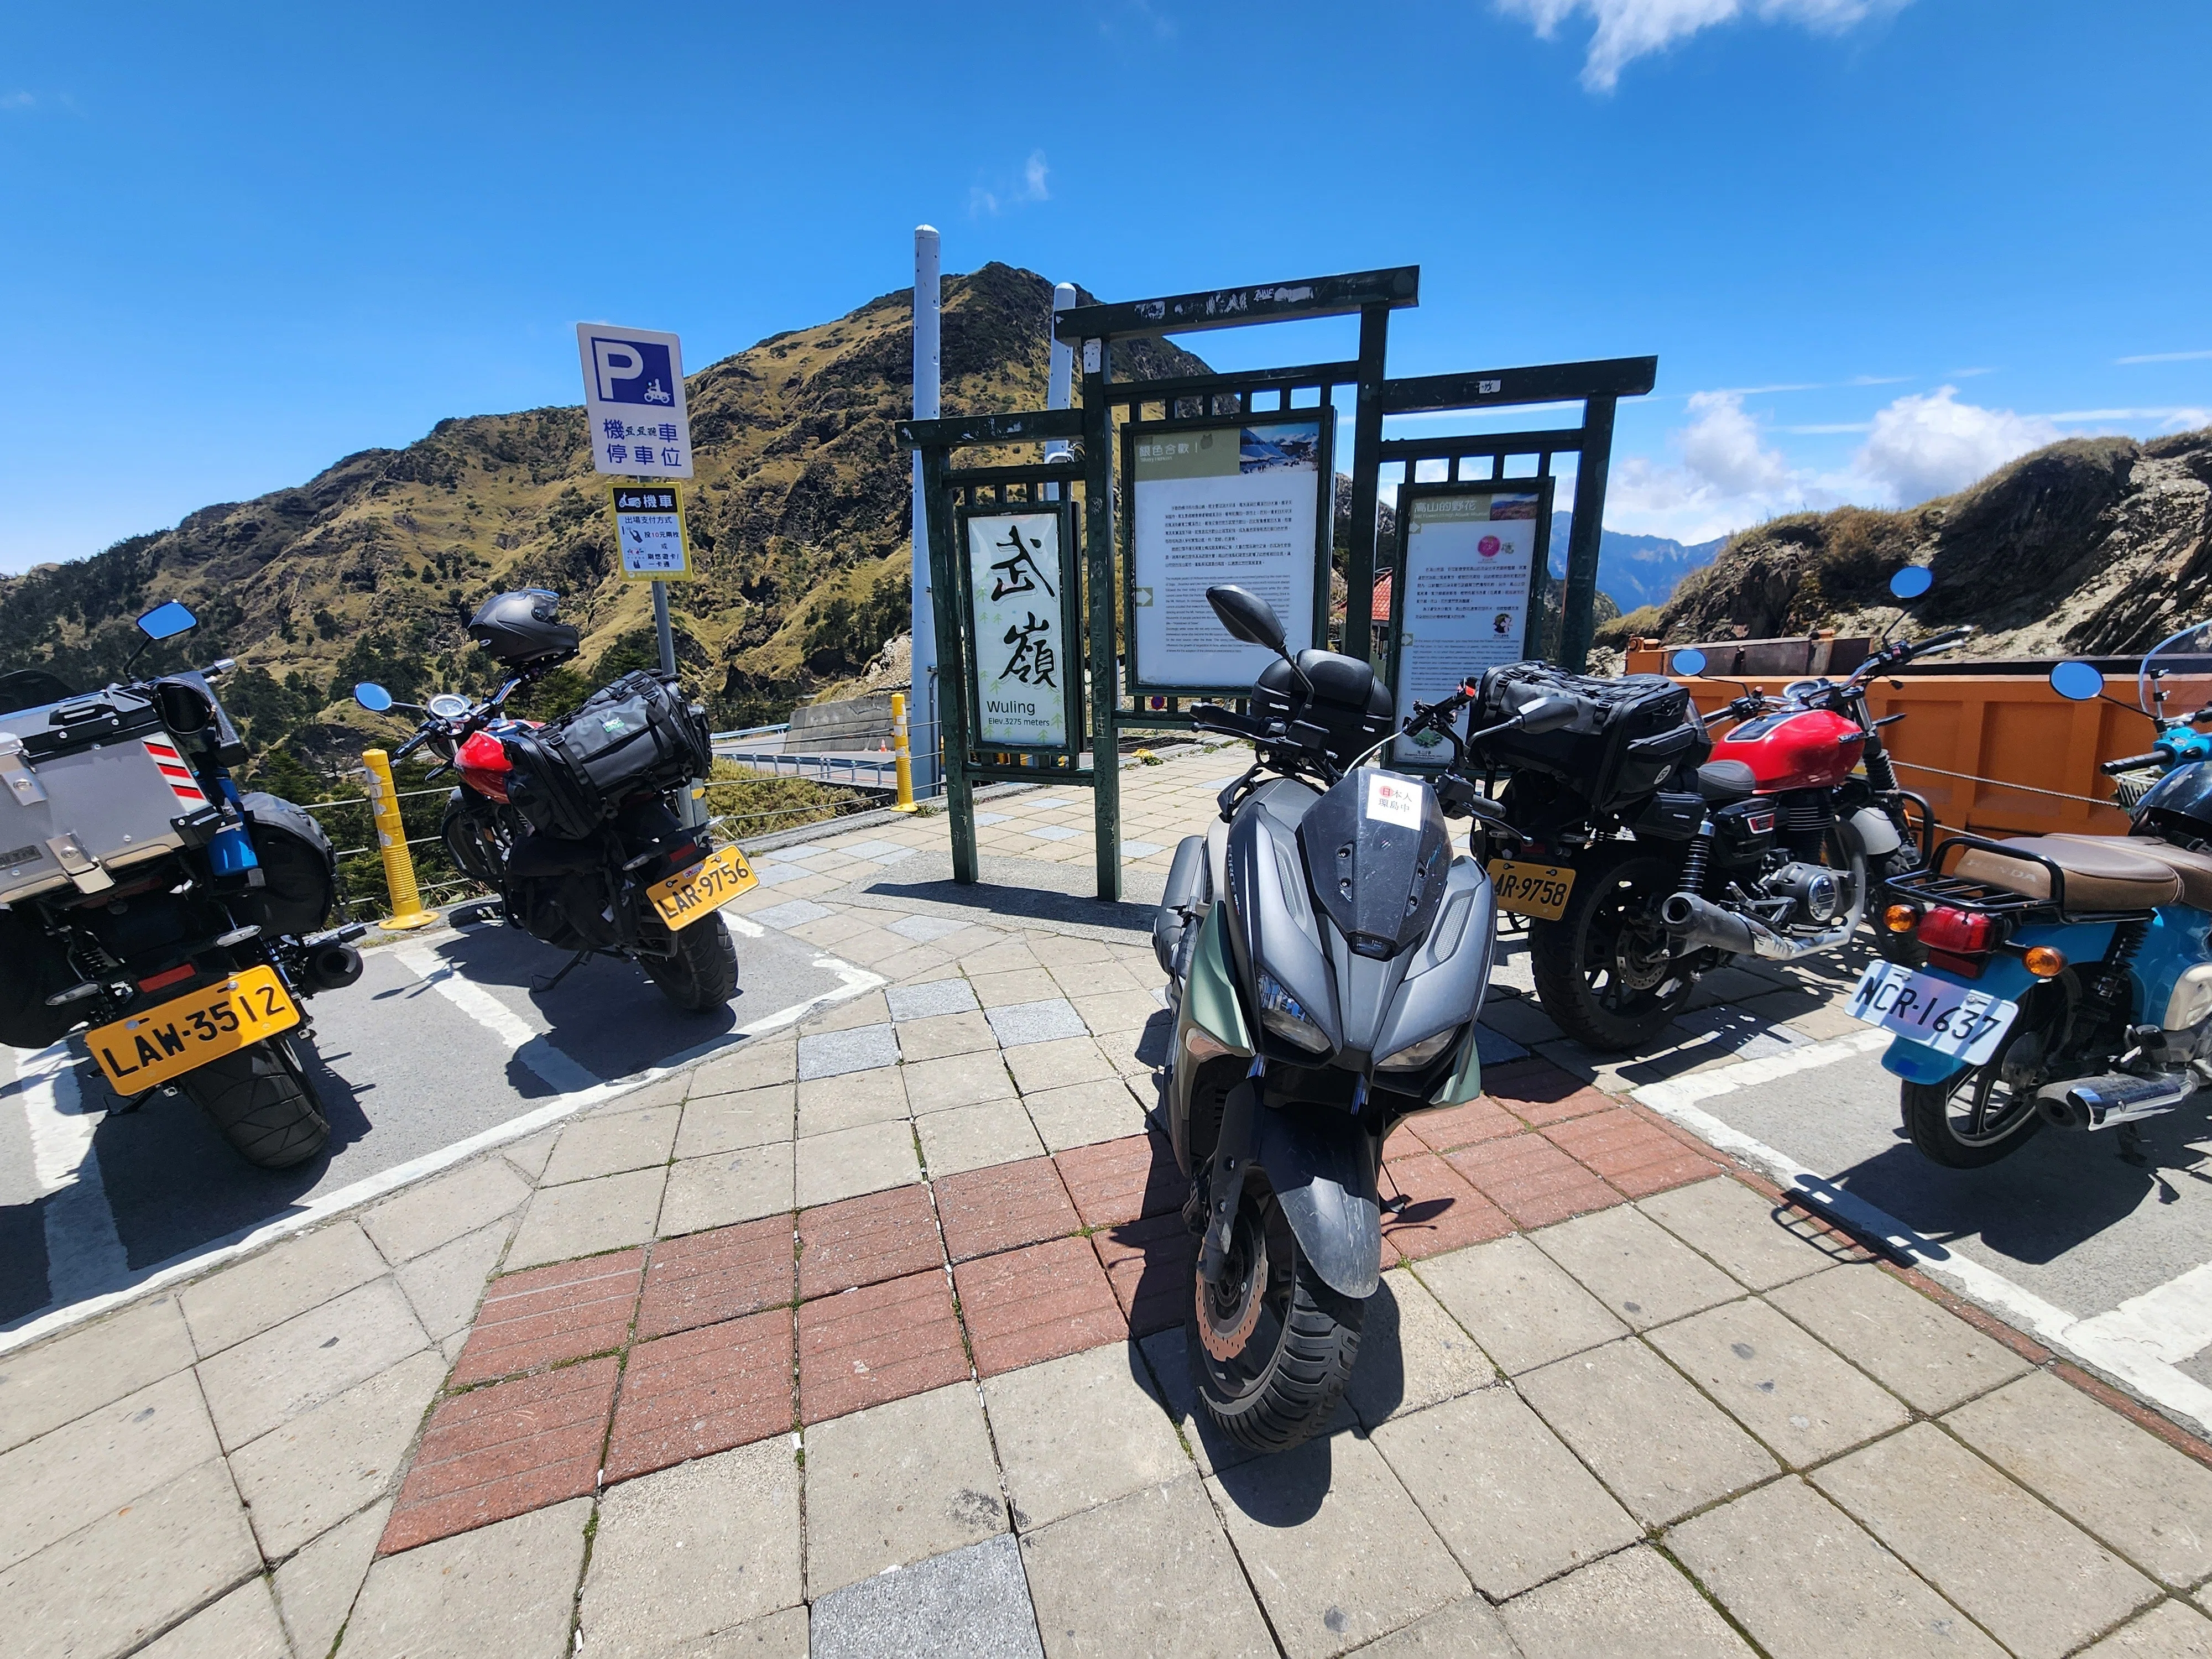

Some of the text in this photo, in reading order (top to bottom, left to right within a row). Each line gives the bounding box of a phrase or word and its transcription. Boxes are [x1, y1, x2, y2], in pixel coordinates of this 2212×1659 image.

[595, 341, 644, 399] P
[607, 444, 682, 467] 停車位
[643, 494, 672, 508] 機車
[1414, 500, 1477, 513] 高山的野花
[987, 701, 1035, 716] Wuling
[1378, 798, 1410, 812] 環島中
[1383, 787, 1412, 802] 日本人
[1228, 844, 1237, 892] FORCE
[657, 858, 749, 920] LAR-9756
[1488, 872, 1567, 907] AR-9758
[1855, 976, 2002, 1044] NCR-1637
[102, 986, 286, 1078] LAW-3512
